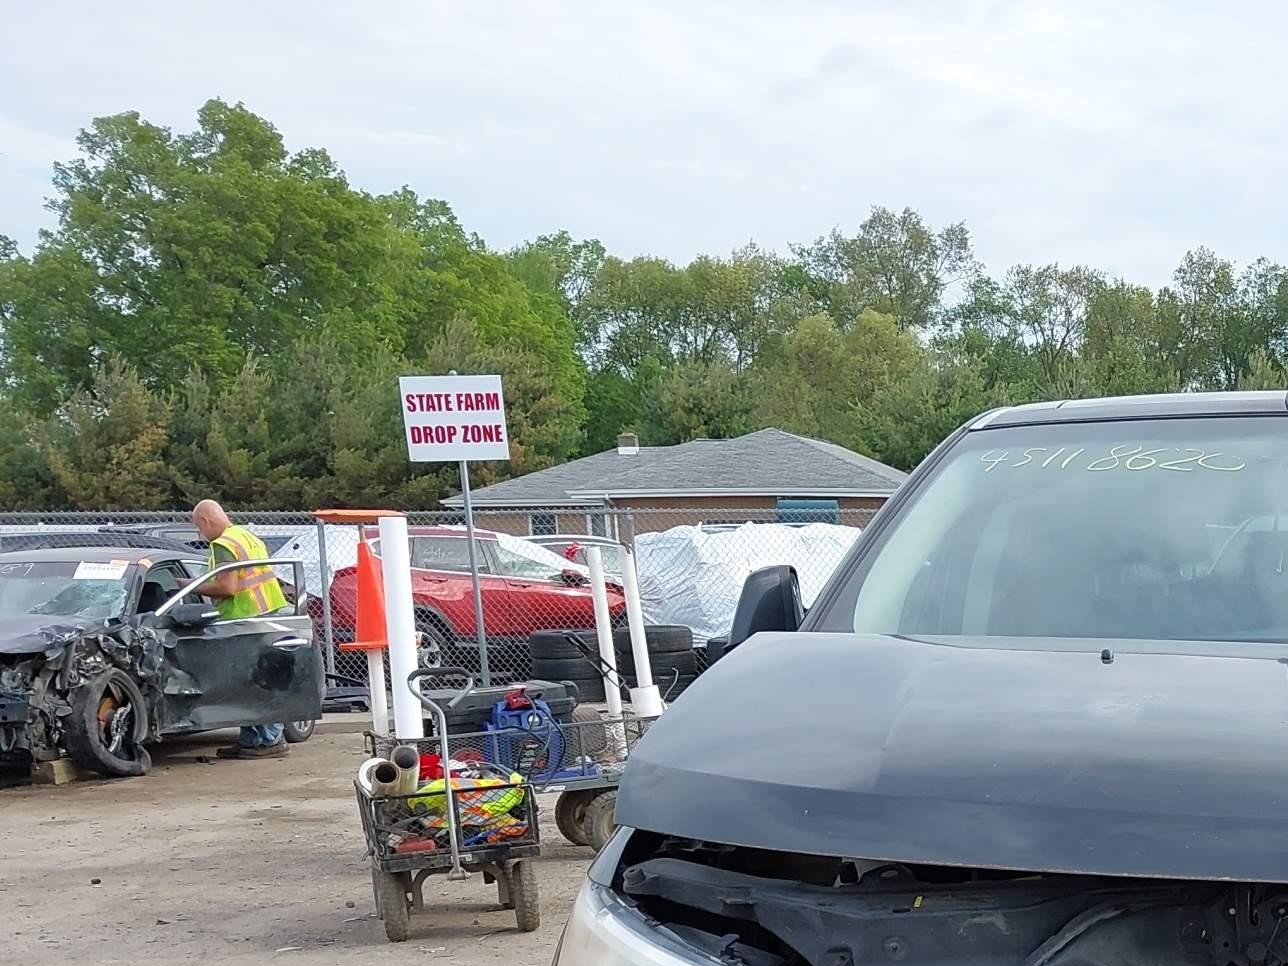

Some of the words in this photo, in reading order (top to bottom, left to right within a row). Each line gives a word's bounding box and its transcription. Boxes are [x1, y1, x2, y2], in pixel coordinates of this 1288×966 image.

[406, 393, 452, 412] STATE
[457, 392, 500, 411] FARM
[410, 425, 457, 444] DROP
[461, 424, 504, 443] ZONE
